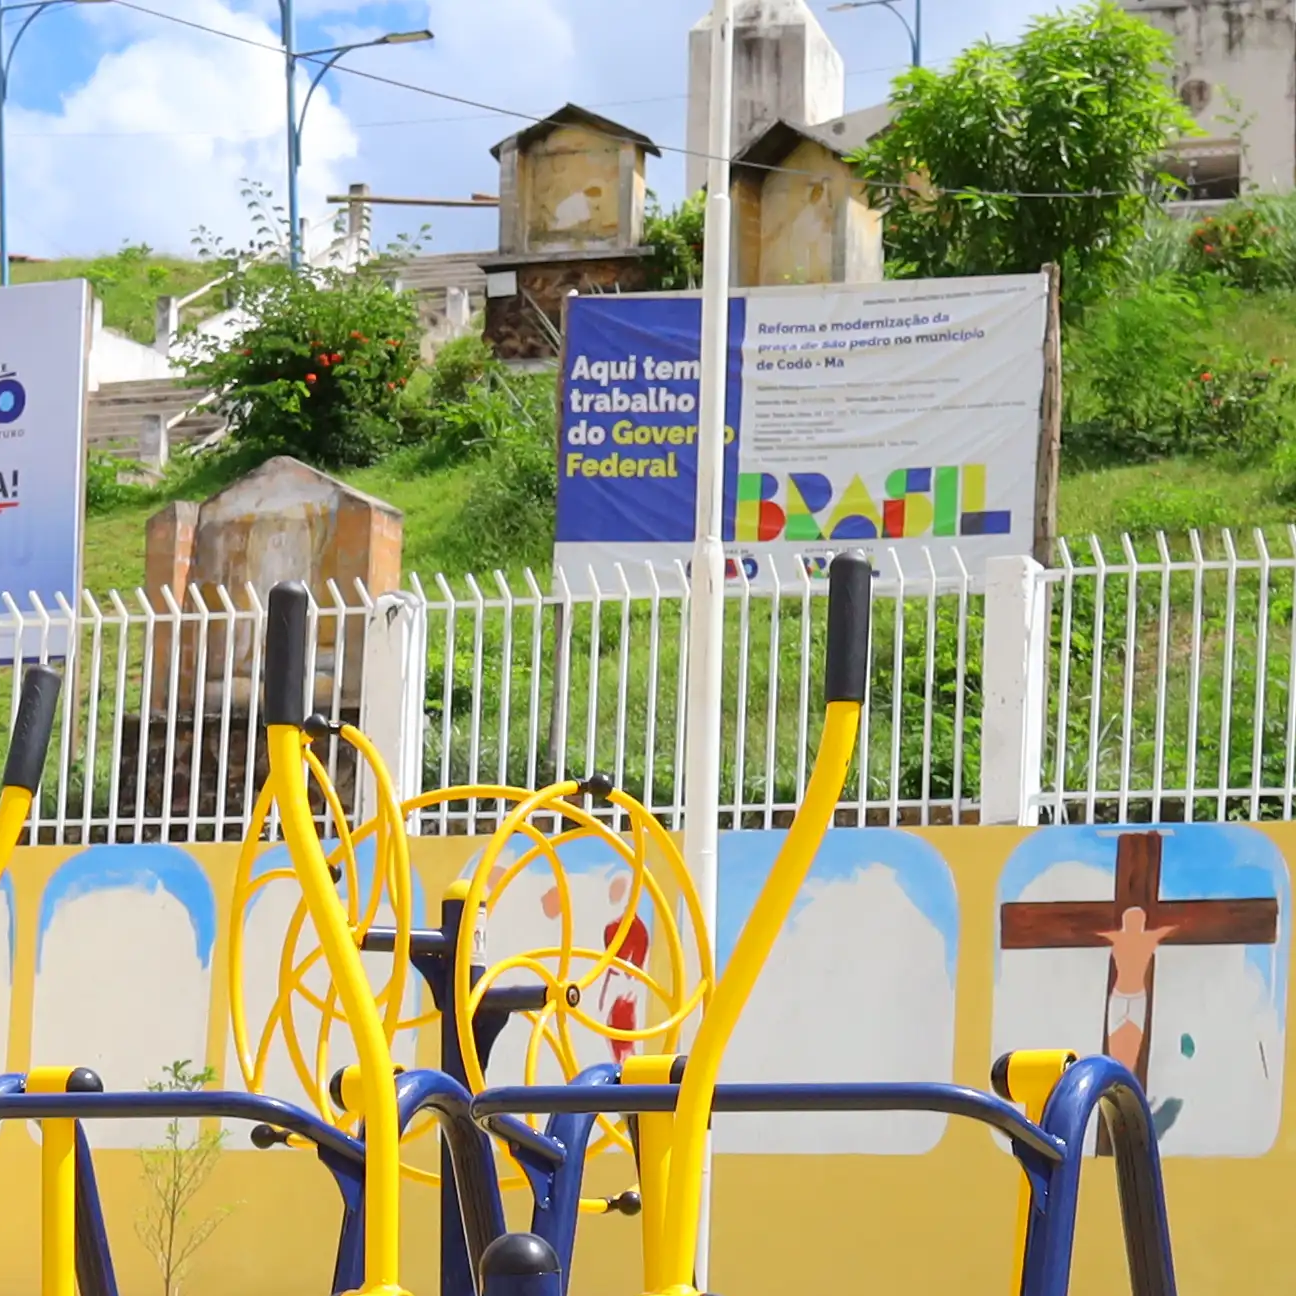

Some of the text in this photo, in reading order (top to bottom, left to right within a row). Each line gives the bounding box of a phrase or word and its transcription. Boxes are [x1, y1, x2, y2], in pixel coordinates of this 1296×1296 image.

[758, 312, 950, 335] Reforma e modernização da
[849, 336, 890, 351] pedro
[894, 336, 911, 345] no
[915, 327, 985, 343] município
[571, 354, 701, 386] Aqui tem
[756, 359, 774, 371] de
[824, 356, 845, 368] Ma
[570, 386, 696, 413] trabalho
[567, 419, 606, 445] do
[611, 419, 735, 445] Govero
[566, 451, 678, 478] Federal
[734, 463, 1011, 542] BRASIL
